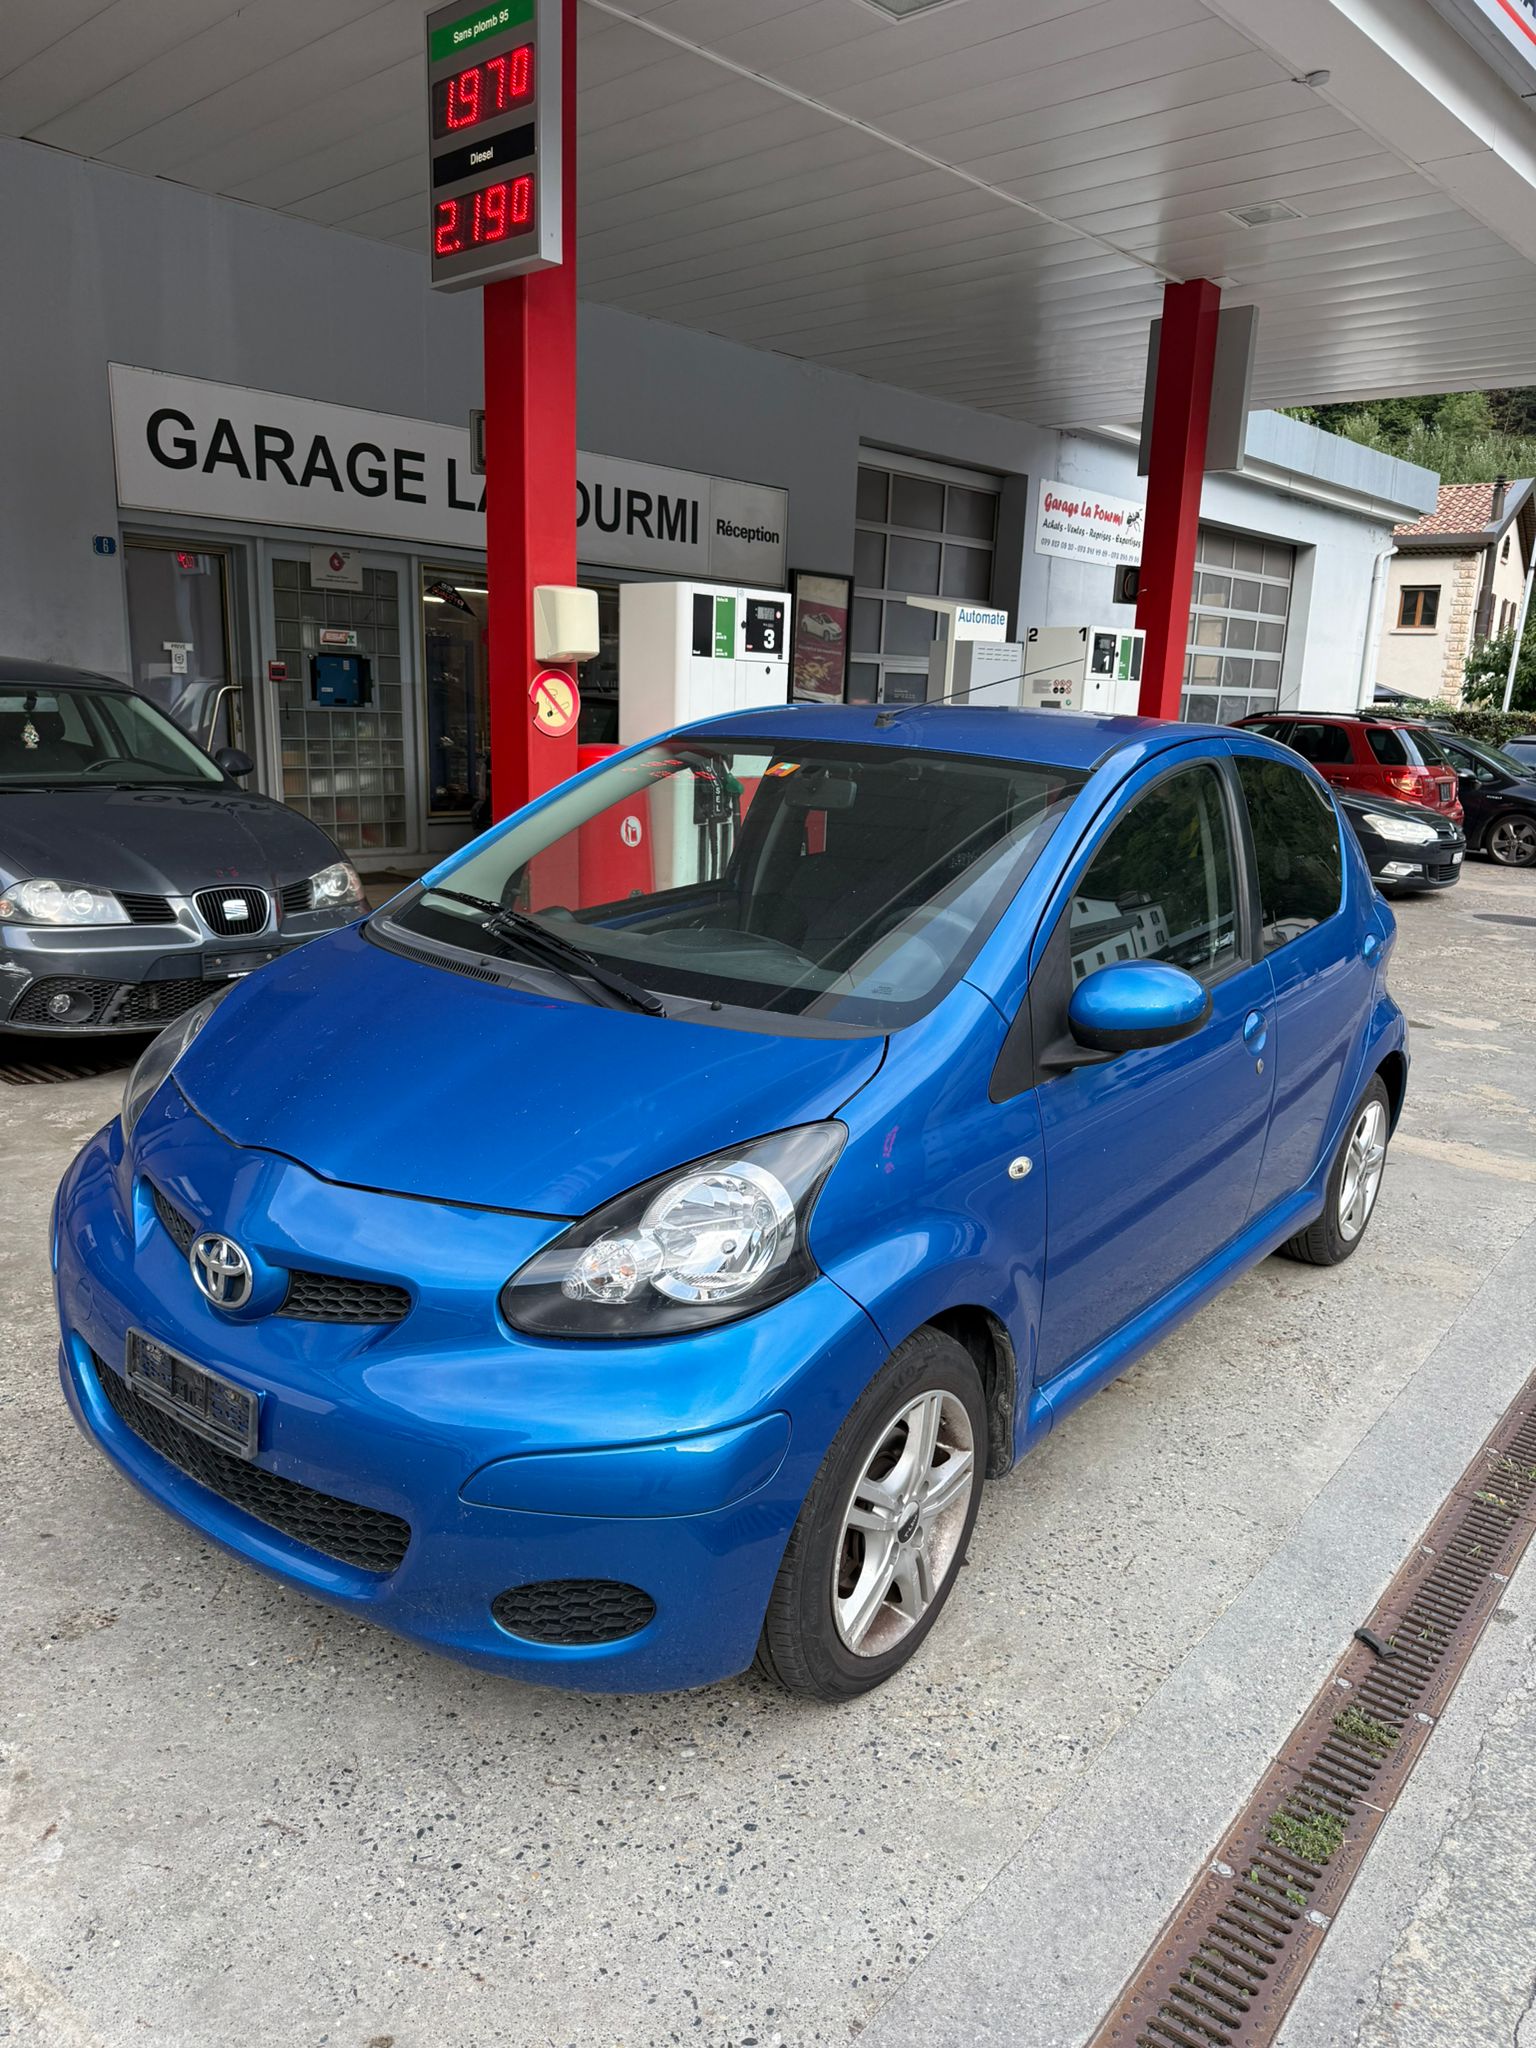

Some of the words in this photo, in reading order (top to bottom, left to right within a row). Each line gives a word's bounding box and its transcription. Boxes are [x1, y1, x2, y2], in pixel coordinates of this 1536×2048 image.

[453, 28, 473, 43] Sans
[473, 14, 498, 38] plomb
[499, 9, 509, 23] 95
[470, 146, 494, 165] Diesel
[146, 408, 427, 504] GARAGE
[448, 458, 487, 512] L
[576, 480, 699, 544] OURMI
[1045, 493, 1079, 518] Garage
[1081, 501, 1092, 518] La
[1094, 504, 1125, 526] Fourmi
[716, 518, 780, 545] Réception
[958, 608, 1006, 626] Automate
[763, 629, 775, 649] 3
[1028, 628, 1038, 642] 2
[1079, 627, 1087, 642] 1
[1103, 655, 1110, 671] 1
